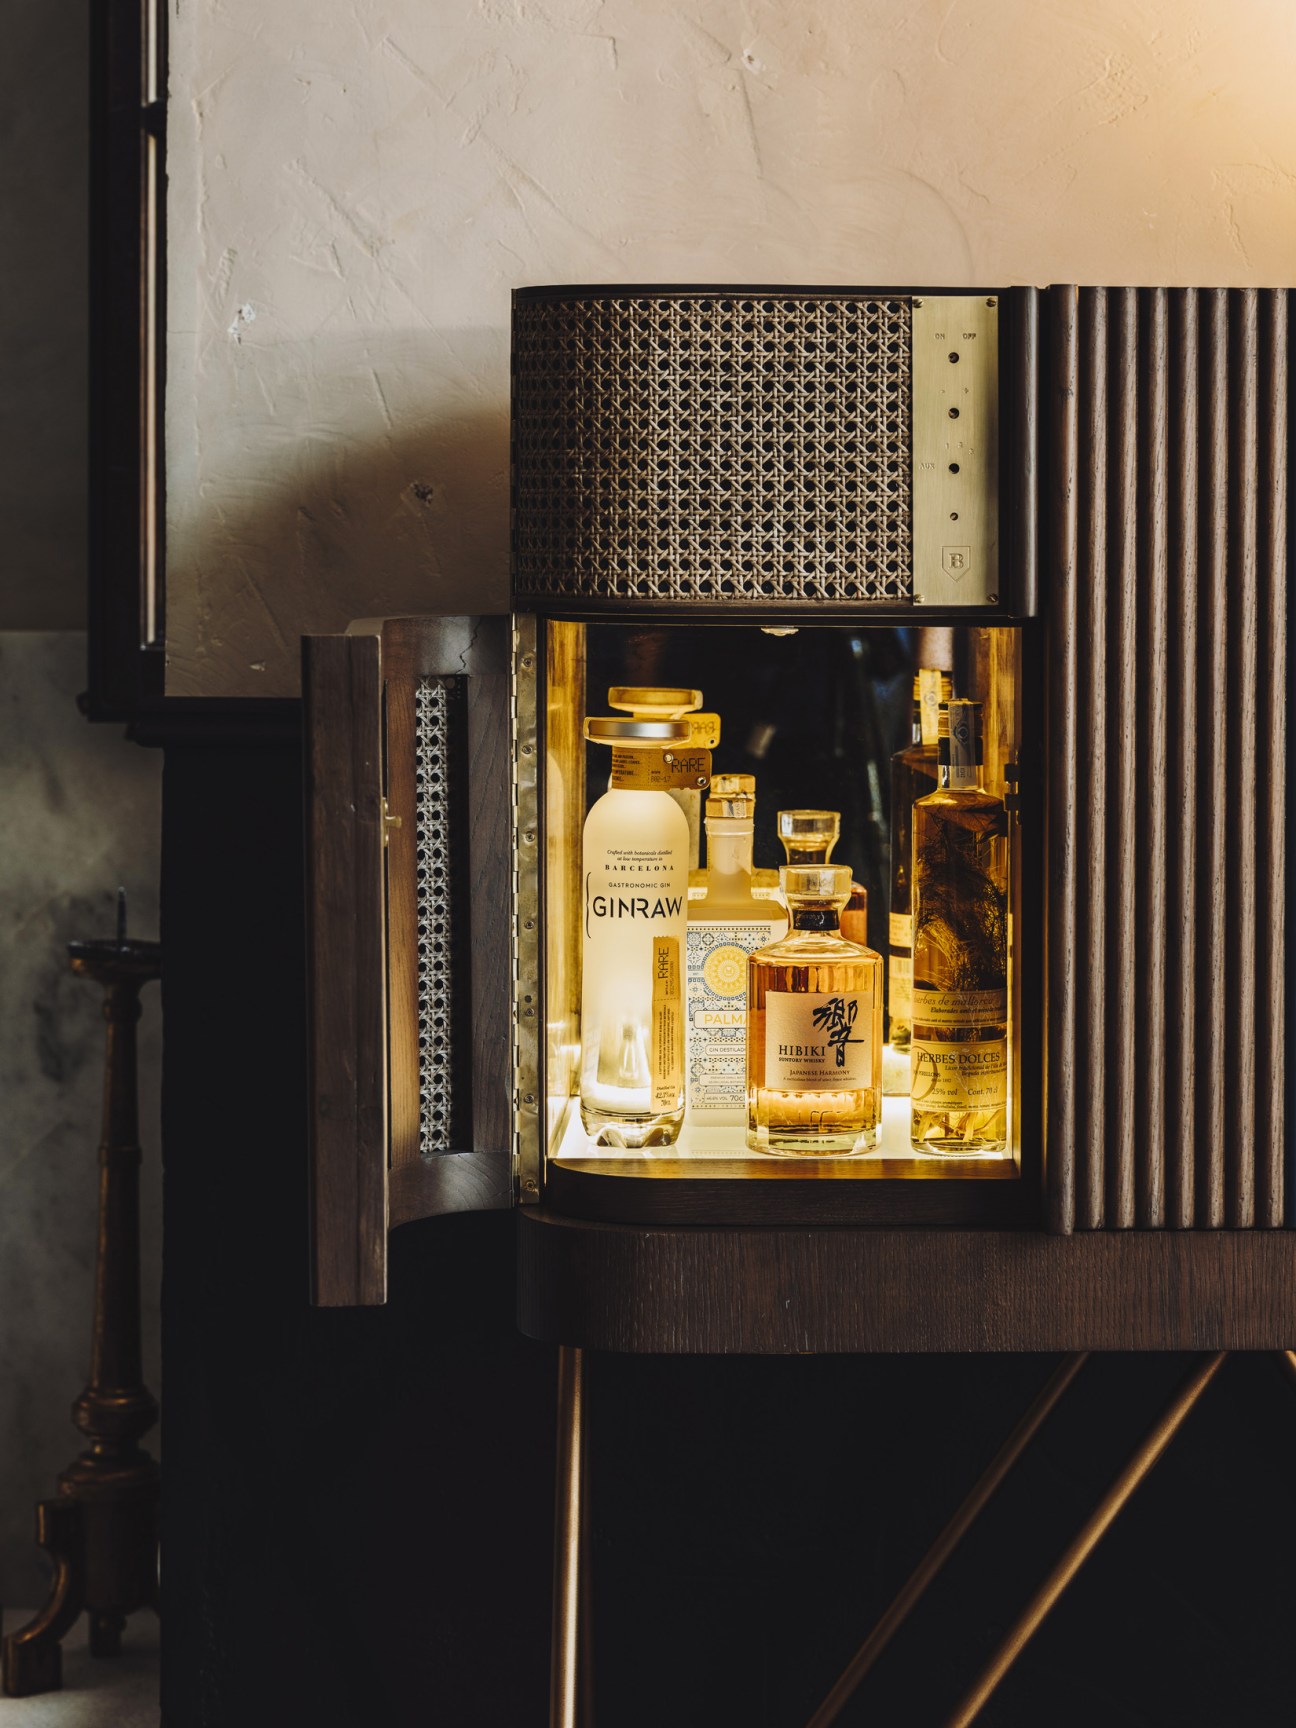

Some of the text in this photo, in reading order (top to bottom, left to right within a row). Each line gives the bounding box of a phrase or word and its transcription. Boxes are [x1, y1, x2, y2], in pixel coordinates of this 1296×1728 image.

[919, 462, 935, 470] AUX
[949, 552, 964, 569] B
[671, 757, 706, 773] RARE
[605, 864, 674, 872] BARCELONA
[592, 895, 683, 919] GINRAW
[657, 947, 670, 979] RARE
[778, 1045, 826, 1057] HIBIKI
[917, 1052, 1000, 1064] HERBES DOLCES
[947, 1088, 958, 1096] vol
[967, 1088, 985, 1096] Cont.
